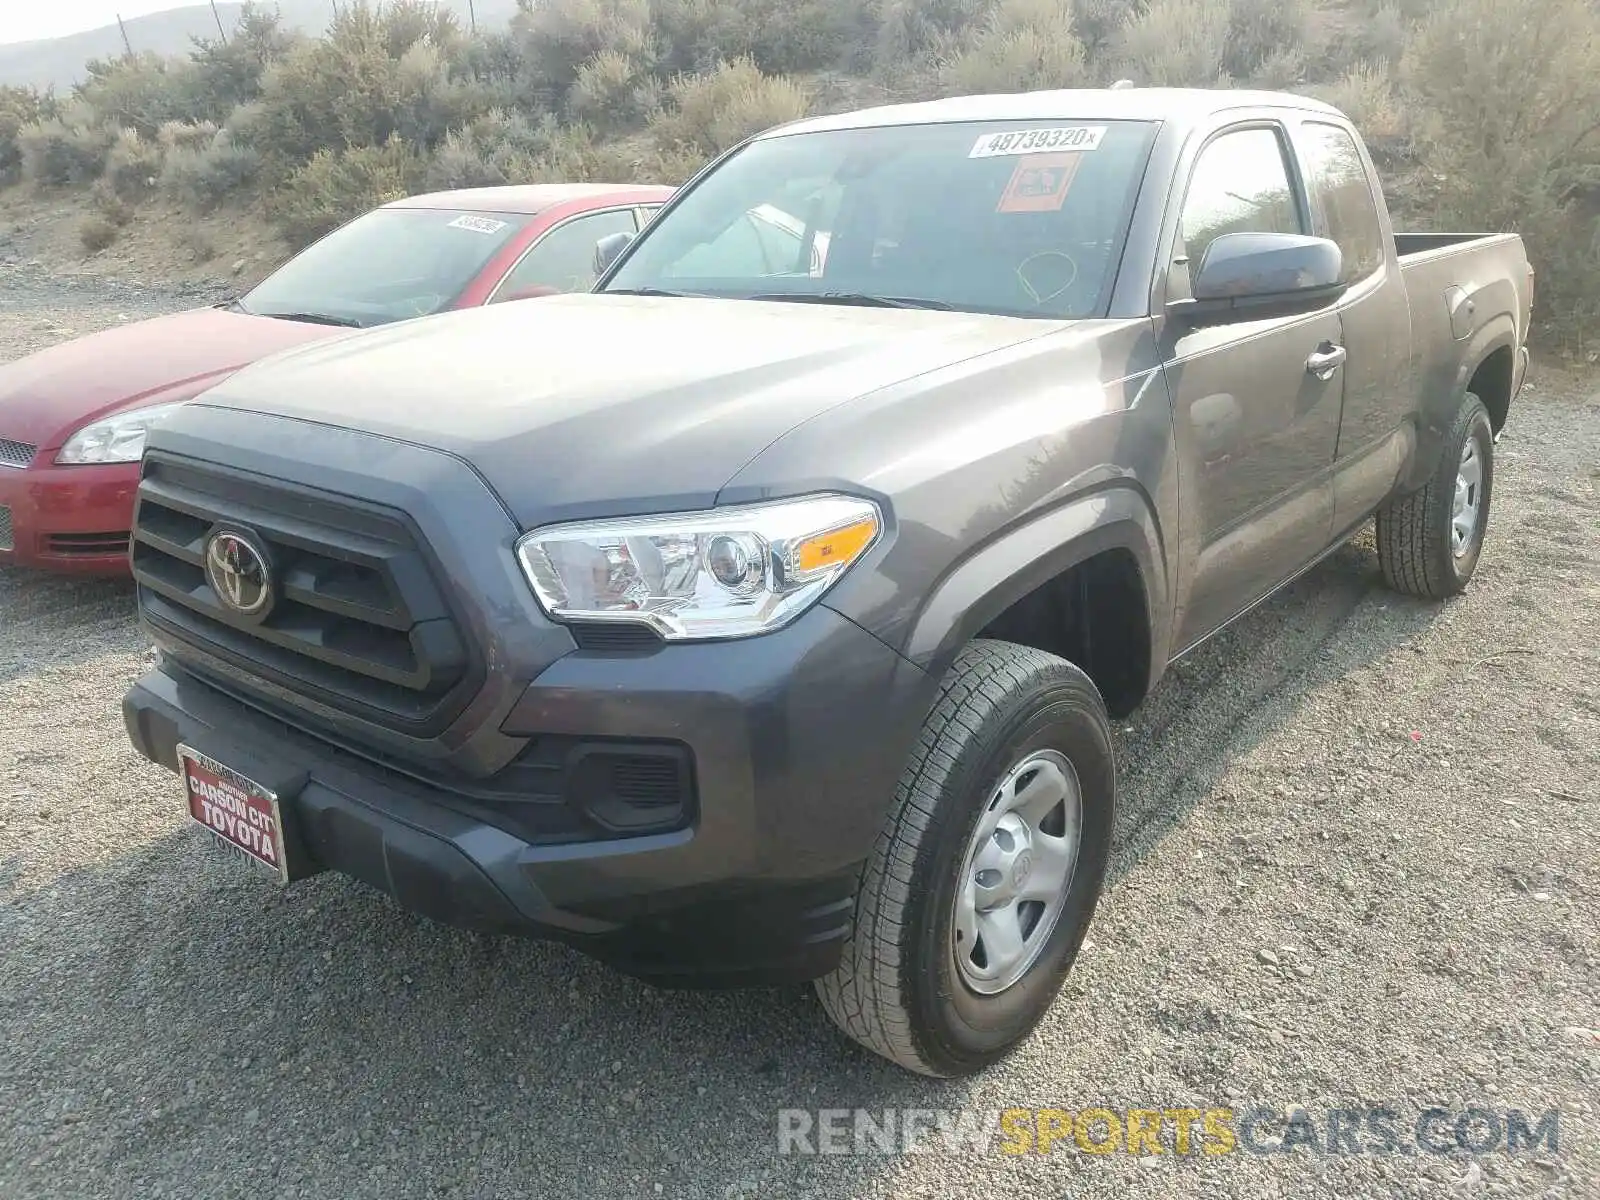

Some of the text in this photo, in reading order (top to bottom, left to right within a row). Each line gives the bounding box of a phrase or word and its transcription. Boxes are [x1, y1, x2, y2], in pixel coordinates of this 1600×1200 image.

[189, 775, 276, 833] CARSON CITY
[201, 800, 275, 861] TOYOTA
